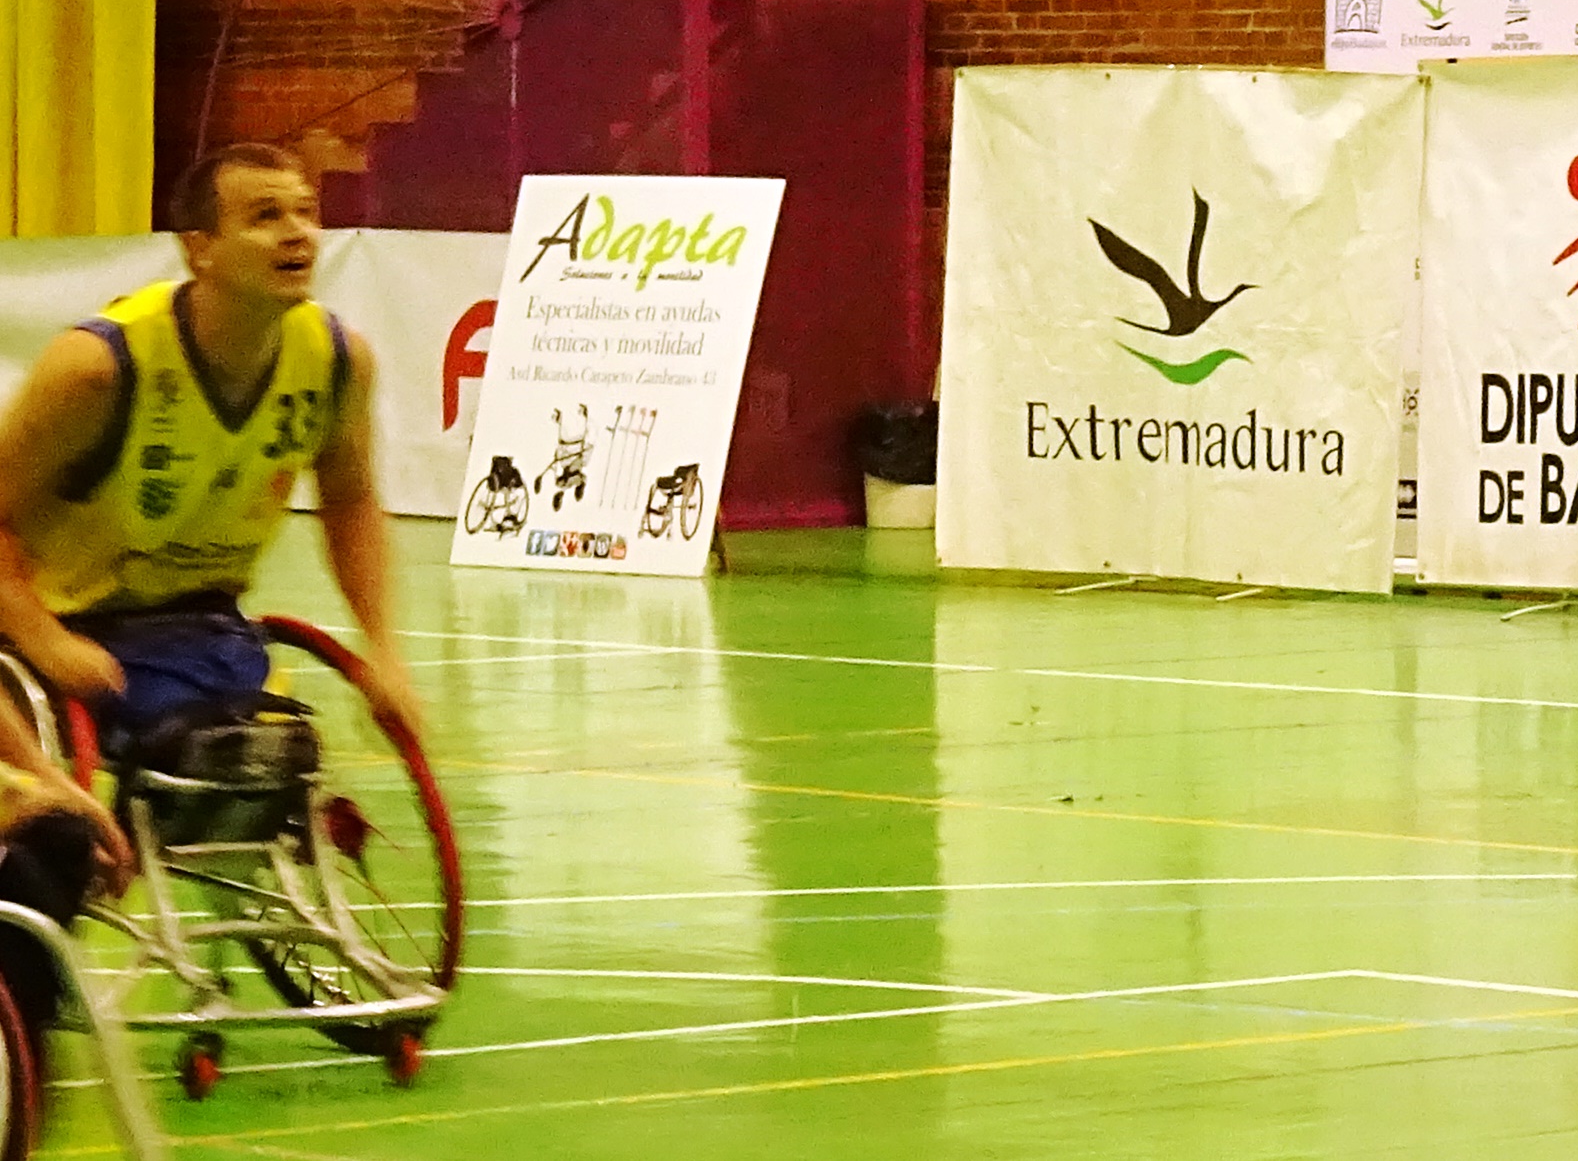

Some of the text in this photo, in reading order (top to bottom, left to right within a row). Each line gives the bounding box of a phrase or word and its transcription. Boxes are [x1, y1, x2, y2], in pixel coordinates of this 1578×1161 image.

[521, 193, 747, 292] Adapta
[527, 295, 721, 326] Especialistas en ayudas
[532, 329, 597, 353] técnicas
[617, 331, 705, 356] movilidad
[1027, 402, 1345, 477] Extremadura
[1478, 470, 1525, 525] DE
